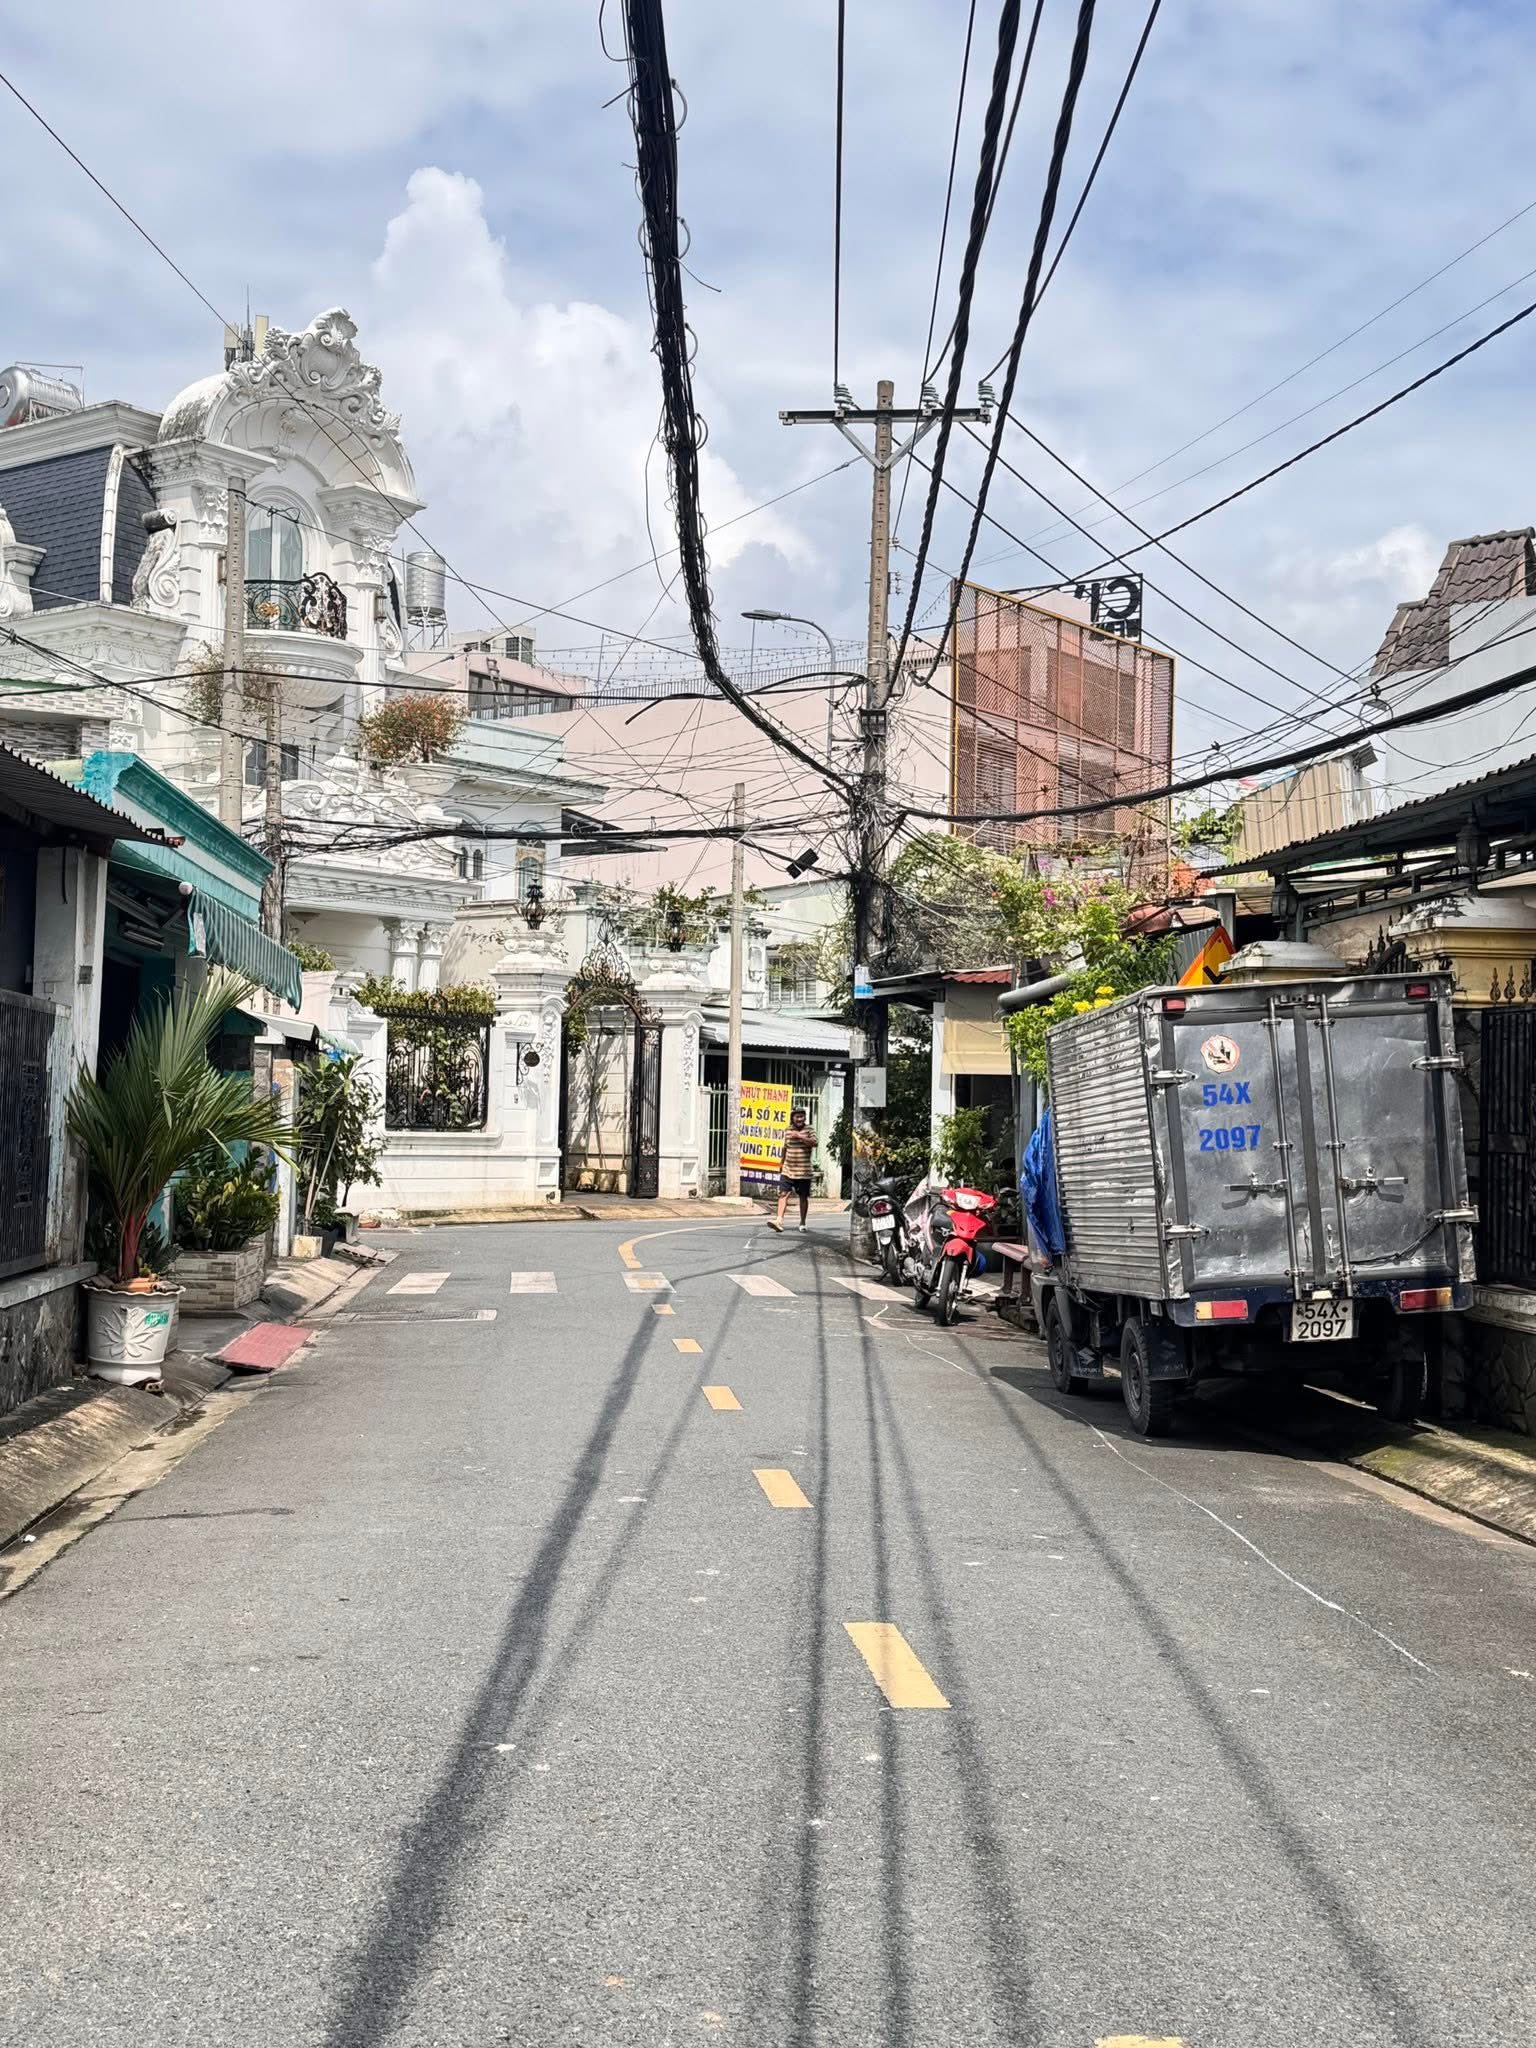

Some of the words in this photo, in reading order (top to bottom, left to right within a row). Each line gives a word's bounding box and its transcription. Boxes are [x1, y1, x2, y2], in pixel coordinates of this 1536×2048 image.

[1203, 1081, 1252, 1107] 54X
[773, 1110, 787, 1123] XE
[1199, 1124, 1261, 1151] 2097
[1304, 1301, 1340, 1319] 54X
[1298, 1319, 1346, 1339] 2097
